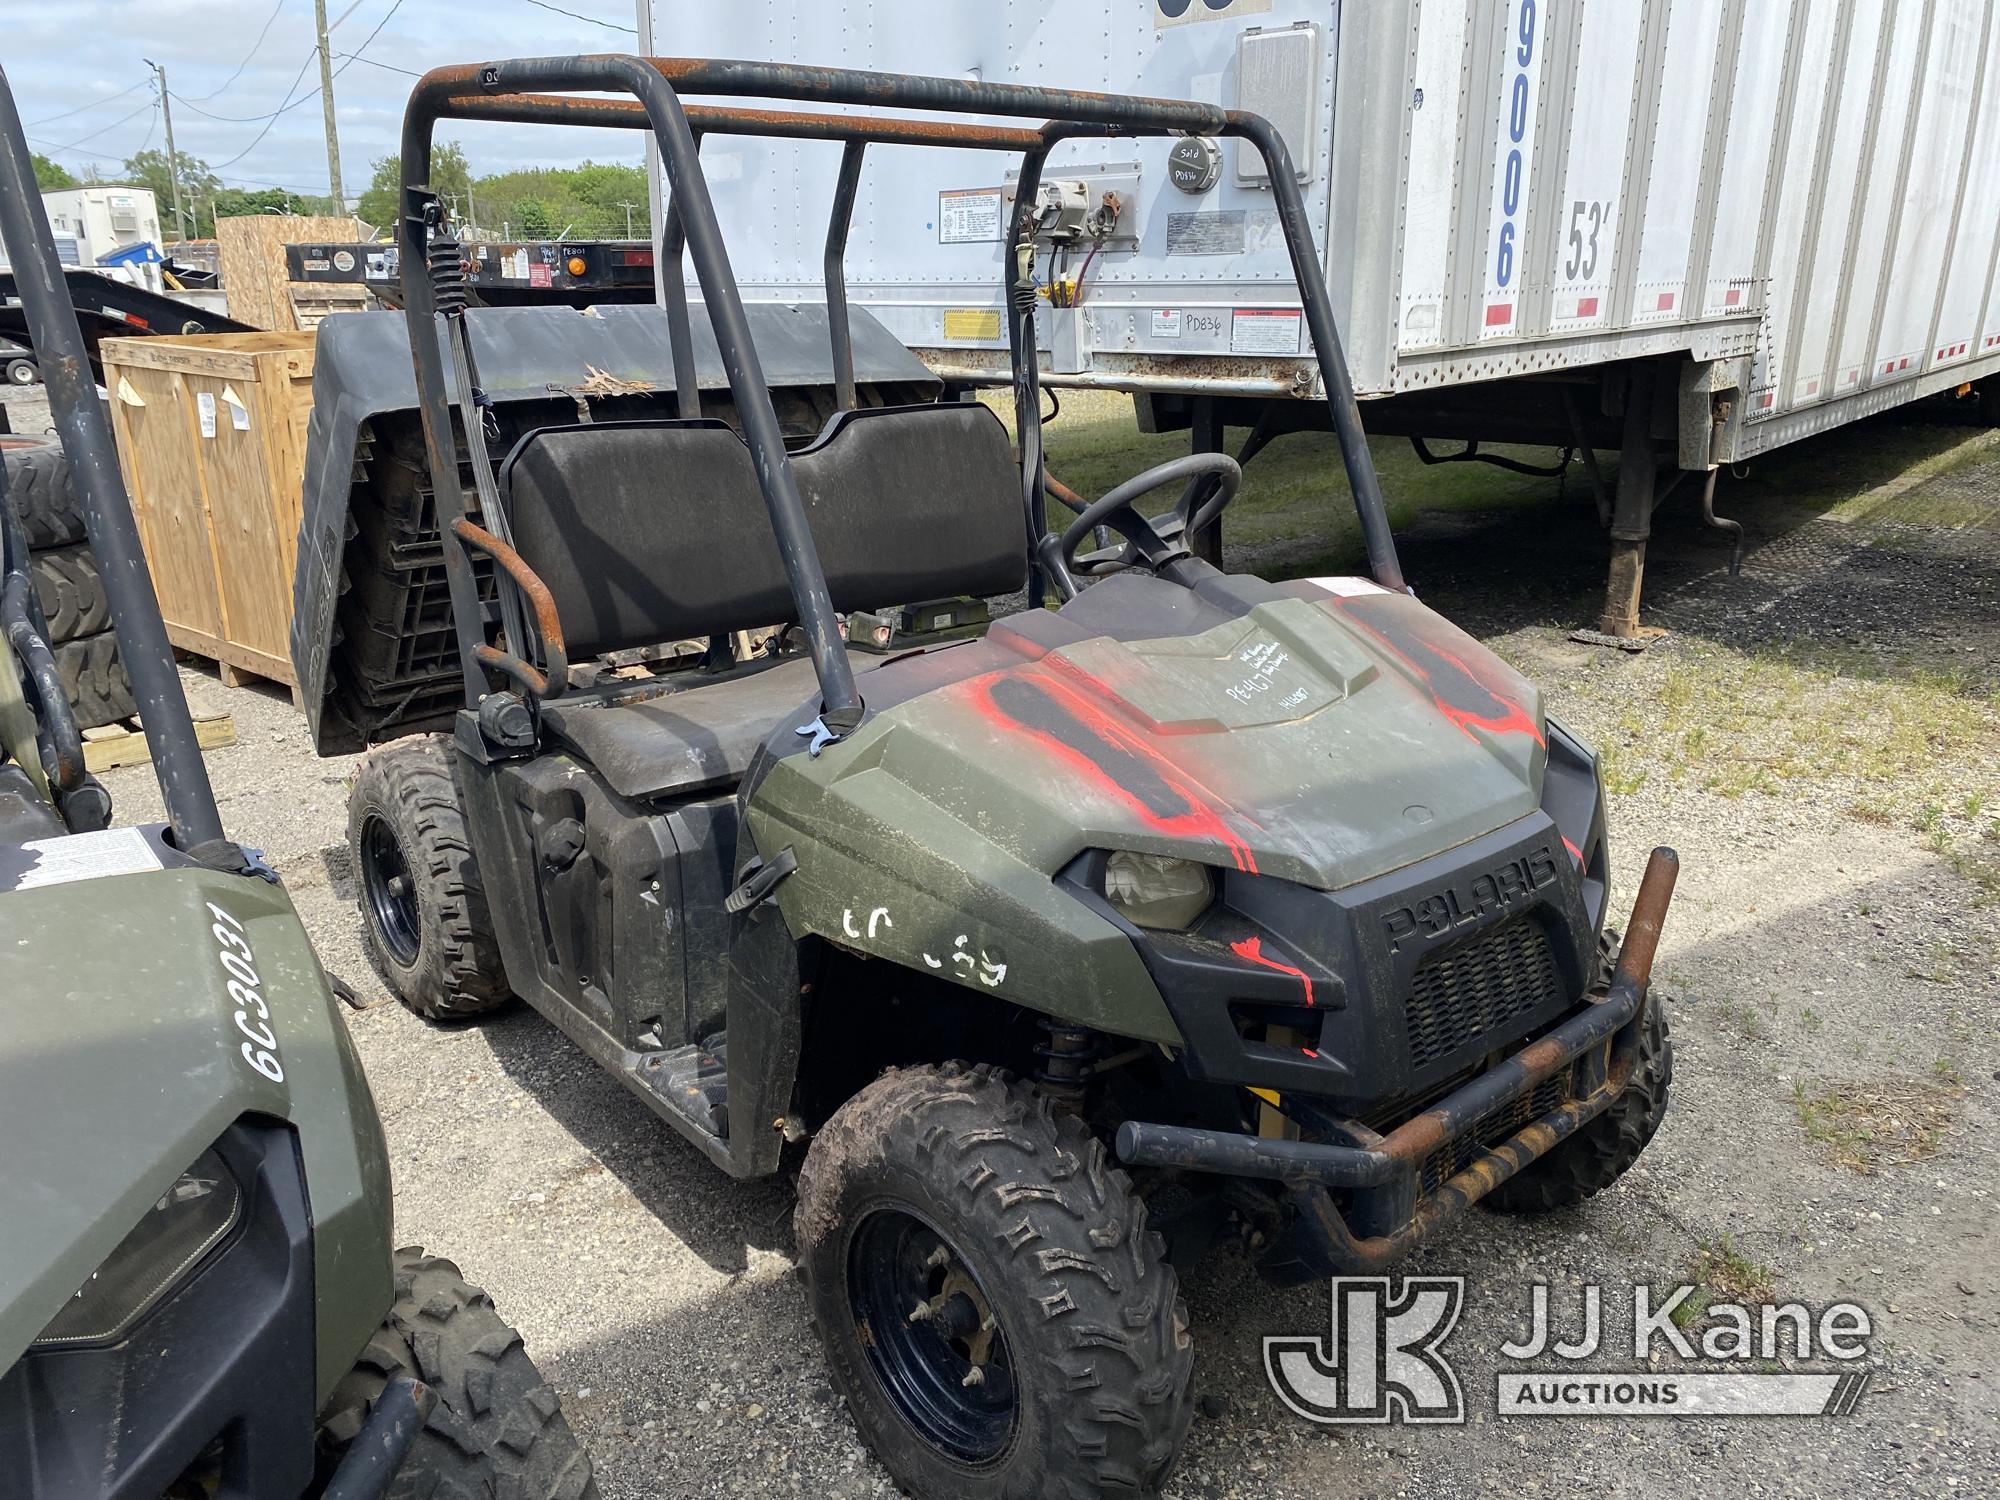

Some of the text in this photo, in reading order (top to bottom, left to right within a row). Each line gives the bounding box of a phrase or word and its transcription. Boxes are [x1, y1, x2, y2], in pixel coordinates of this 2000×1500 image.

[1180, 148, 1199, 159] Sold
[1497, 0, 1535, 287] 9006
[1175, 170, 1197, 181] PD836
[1186, 314, 1222, 331] PD836
[1225, 673, 1274, 706] PE467
[1381, 846, 1558, 954] POLARIS
[206, 902, 284, 1083] 6C3031
